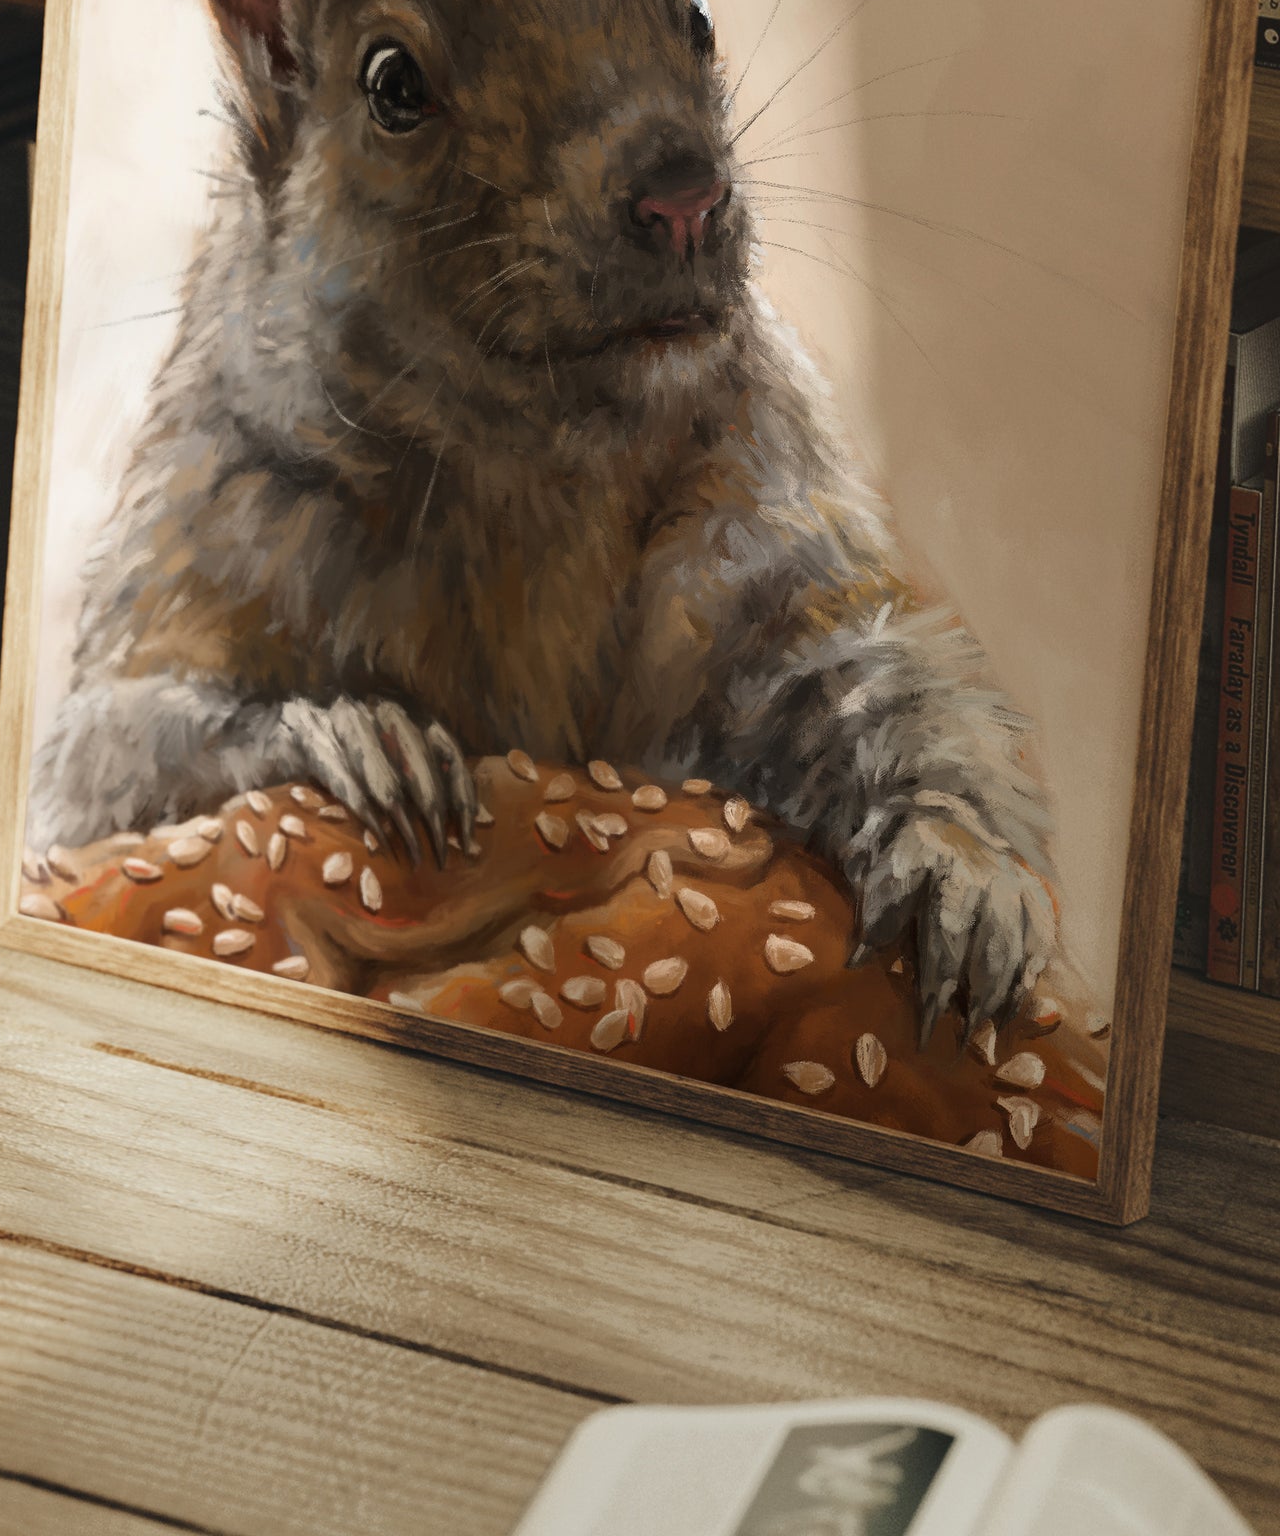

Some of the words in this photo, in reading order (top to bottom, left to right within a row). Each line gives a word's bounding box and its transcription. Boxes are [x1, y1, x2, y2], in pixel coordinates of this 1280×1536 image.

[1230, 511, 1257, 585] Tyndall
[1223, 615, 1253, 700] Faraday
[1224, 707, 1241, 732] as
[1224, 740, 1239, 752] a
[1219, 762, 1247, 877] Discoverer
